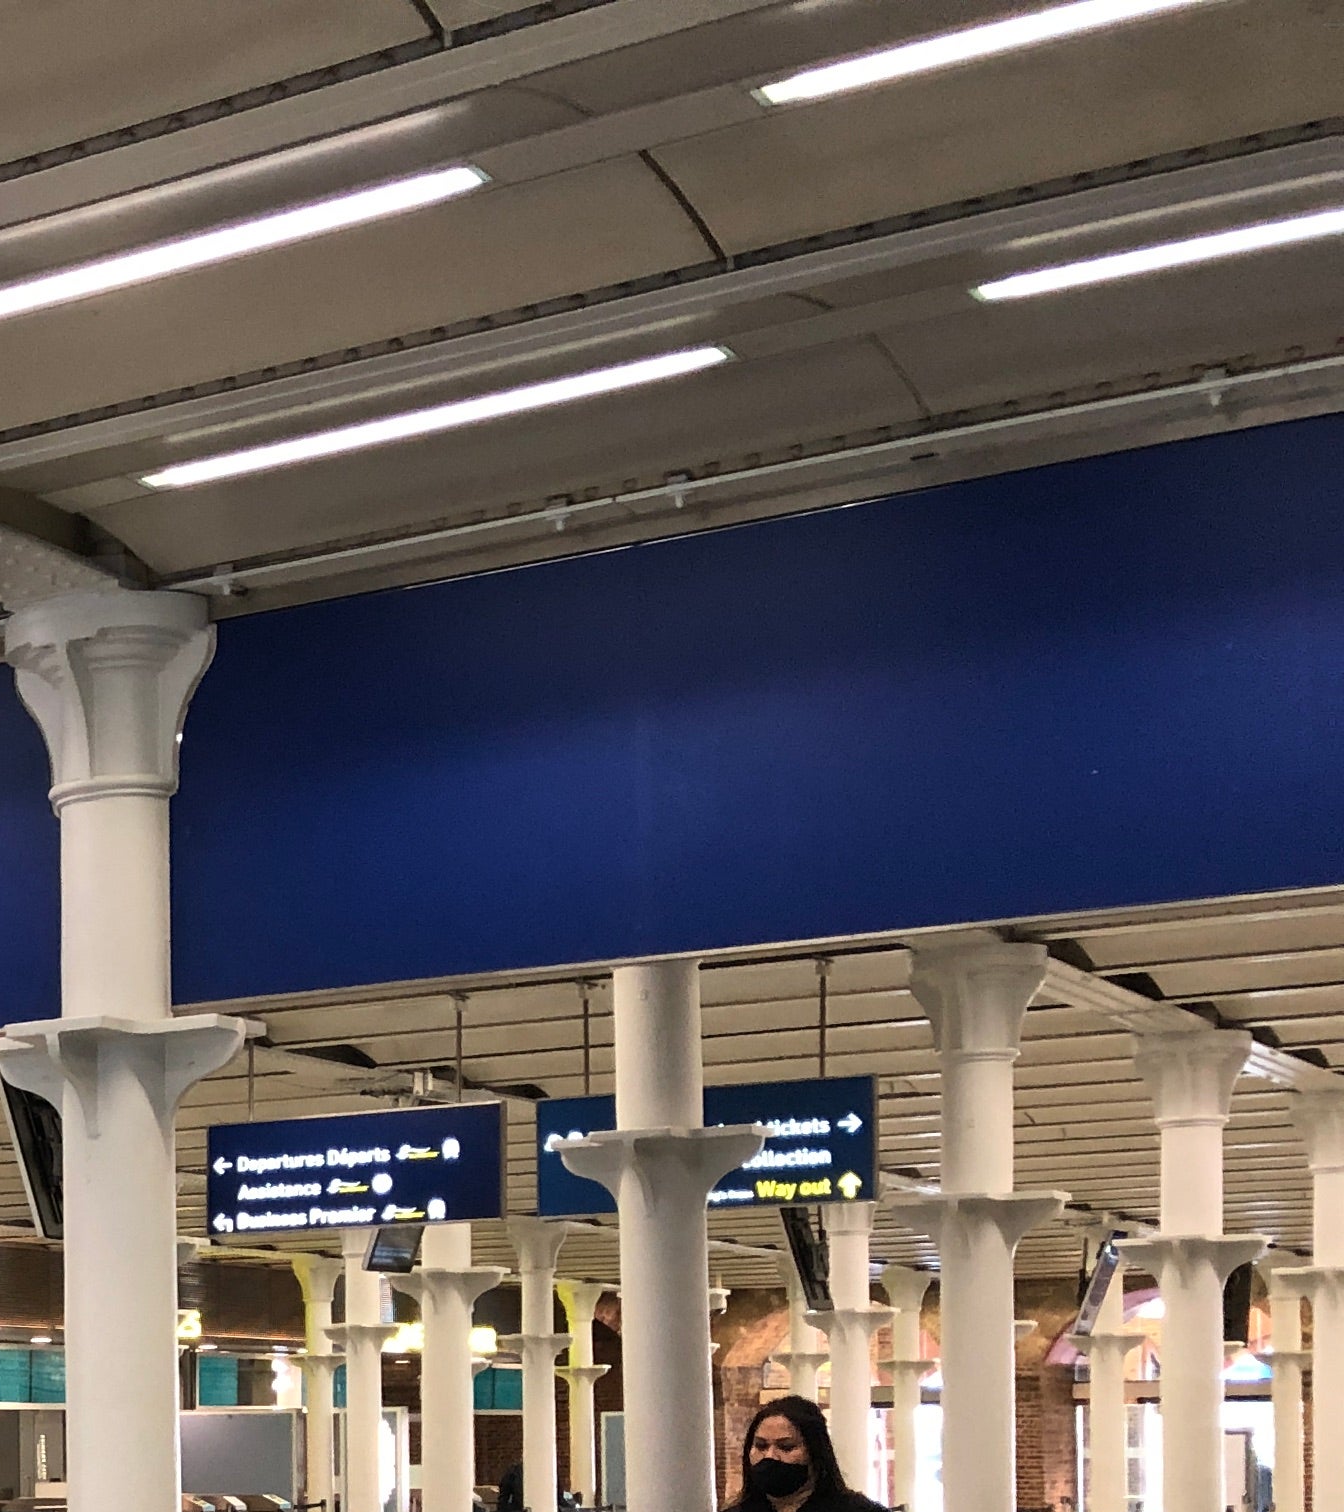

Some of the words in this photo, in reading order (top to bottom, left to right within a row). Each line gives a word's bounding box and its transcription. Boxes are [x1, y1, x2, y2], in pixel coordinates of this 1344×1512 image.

[237, 1153, 325, 1174] Departures
[327, 1147, 391, 1168] Départs
[741, 1147, 832, 1168] ollection
[237, 1179, 322, 1200] Assistance
[756, 1179, 797, 1200] Way
[799, 1178, 832, 1197] out
[236, 1210, 308, 1230] Business
[309, 1206, 377, 1226] Premier
